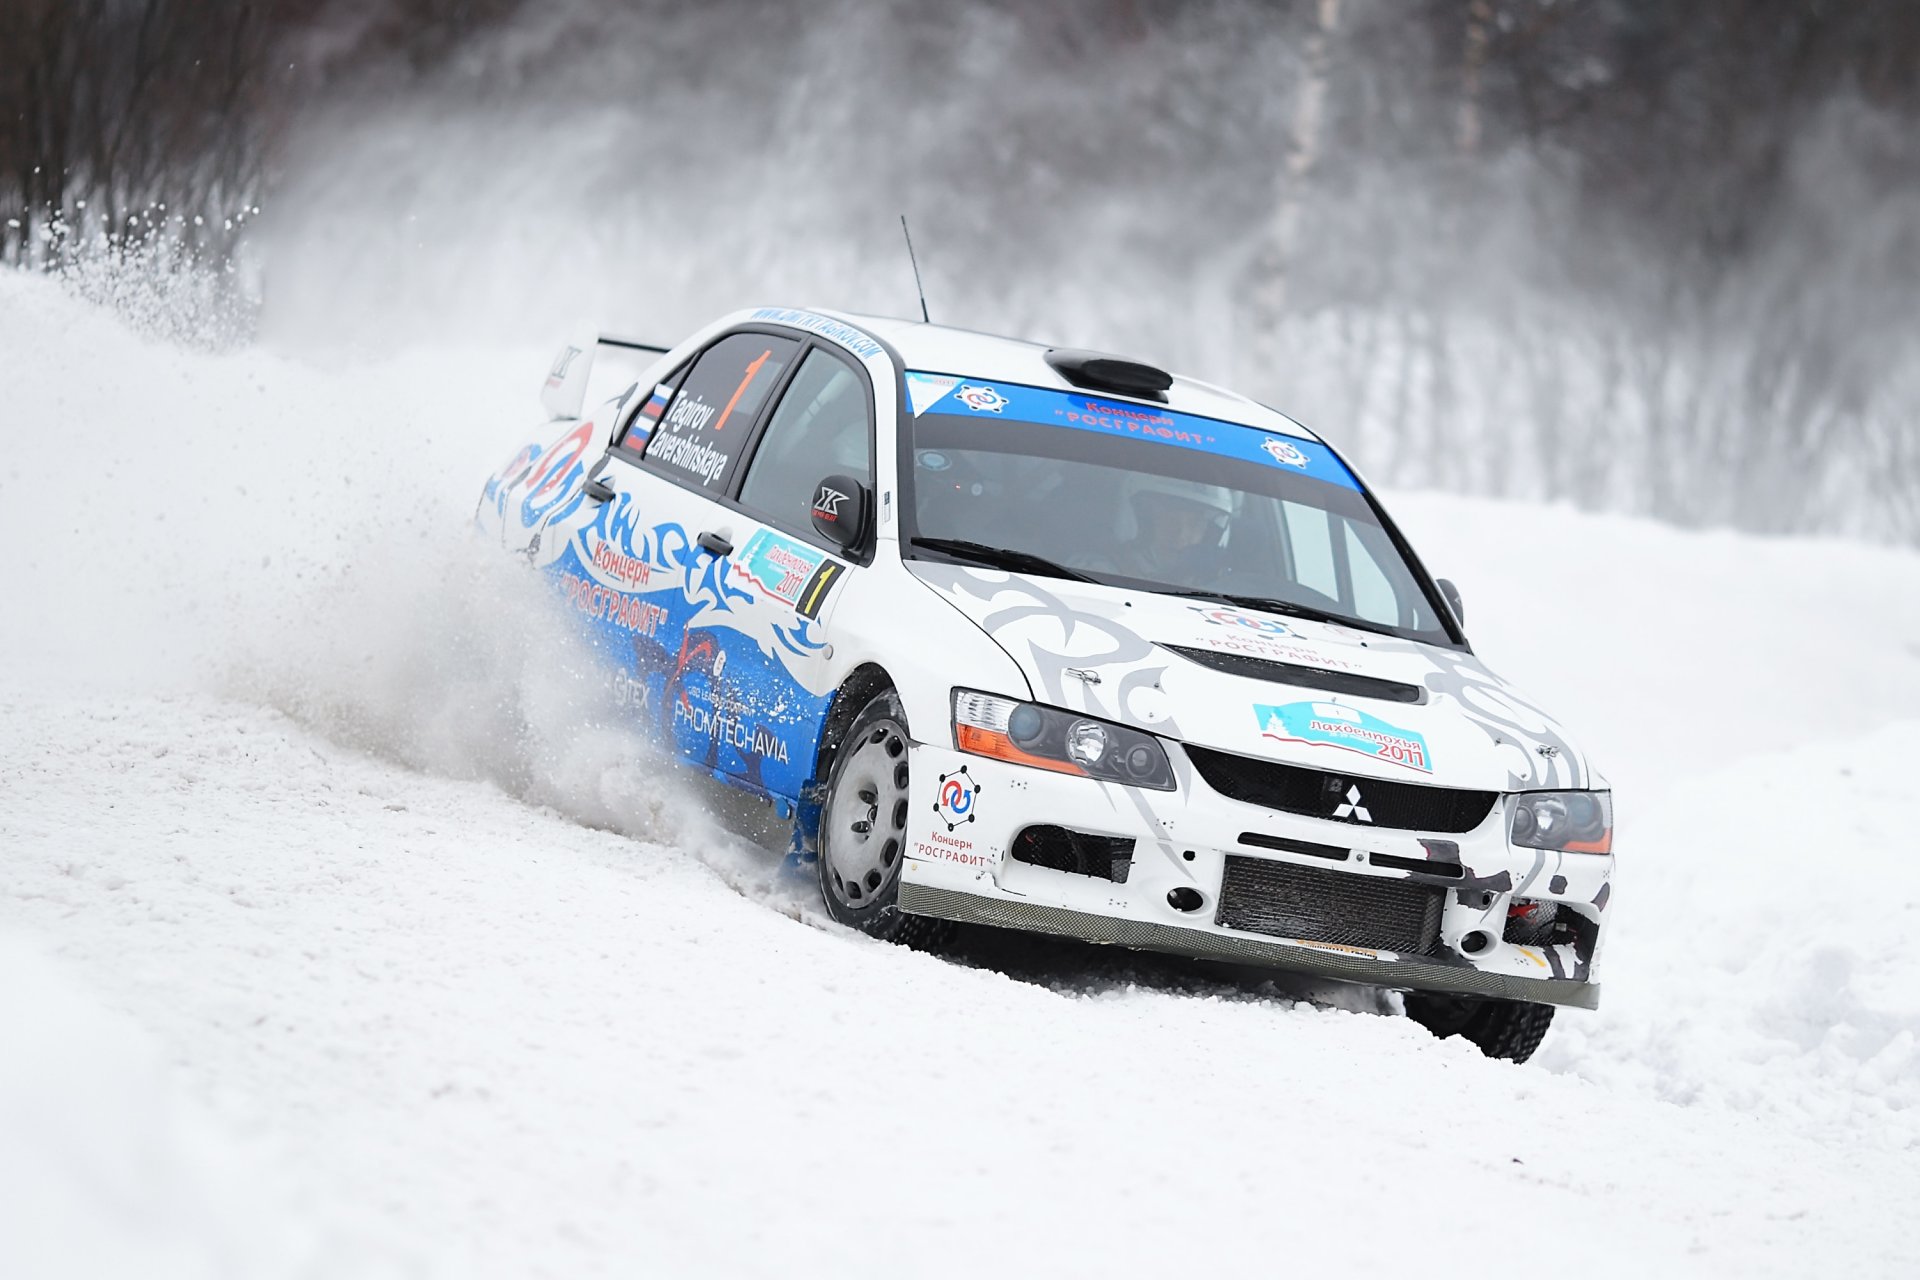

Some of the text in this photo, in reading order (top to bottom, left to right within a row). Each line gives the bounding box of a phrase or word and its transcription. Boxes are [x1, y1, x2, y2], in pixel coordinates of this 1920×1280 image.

[665, 389, 716, 433] Tagirov
[714, 349, 772, 431] 1
[1086, 401, 1175, 426] Концерн
[645, 421, 729, 487] Zavershinskaya
[592, 539, 651, 589] Концерн
[775, 569, 803, 599] 2011
[804, 564, 837, 615] 1
[674, 699, 790, 765] PROMTECHAVIA
[1377, 741, 1425, 767] 2011
[931, 831, 973, 850] Концерн
